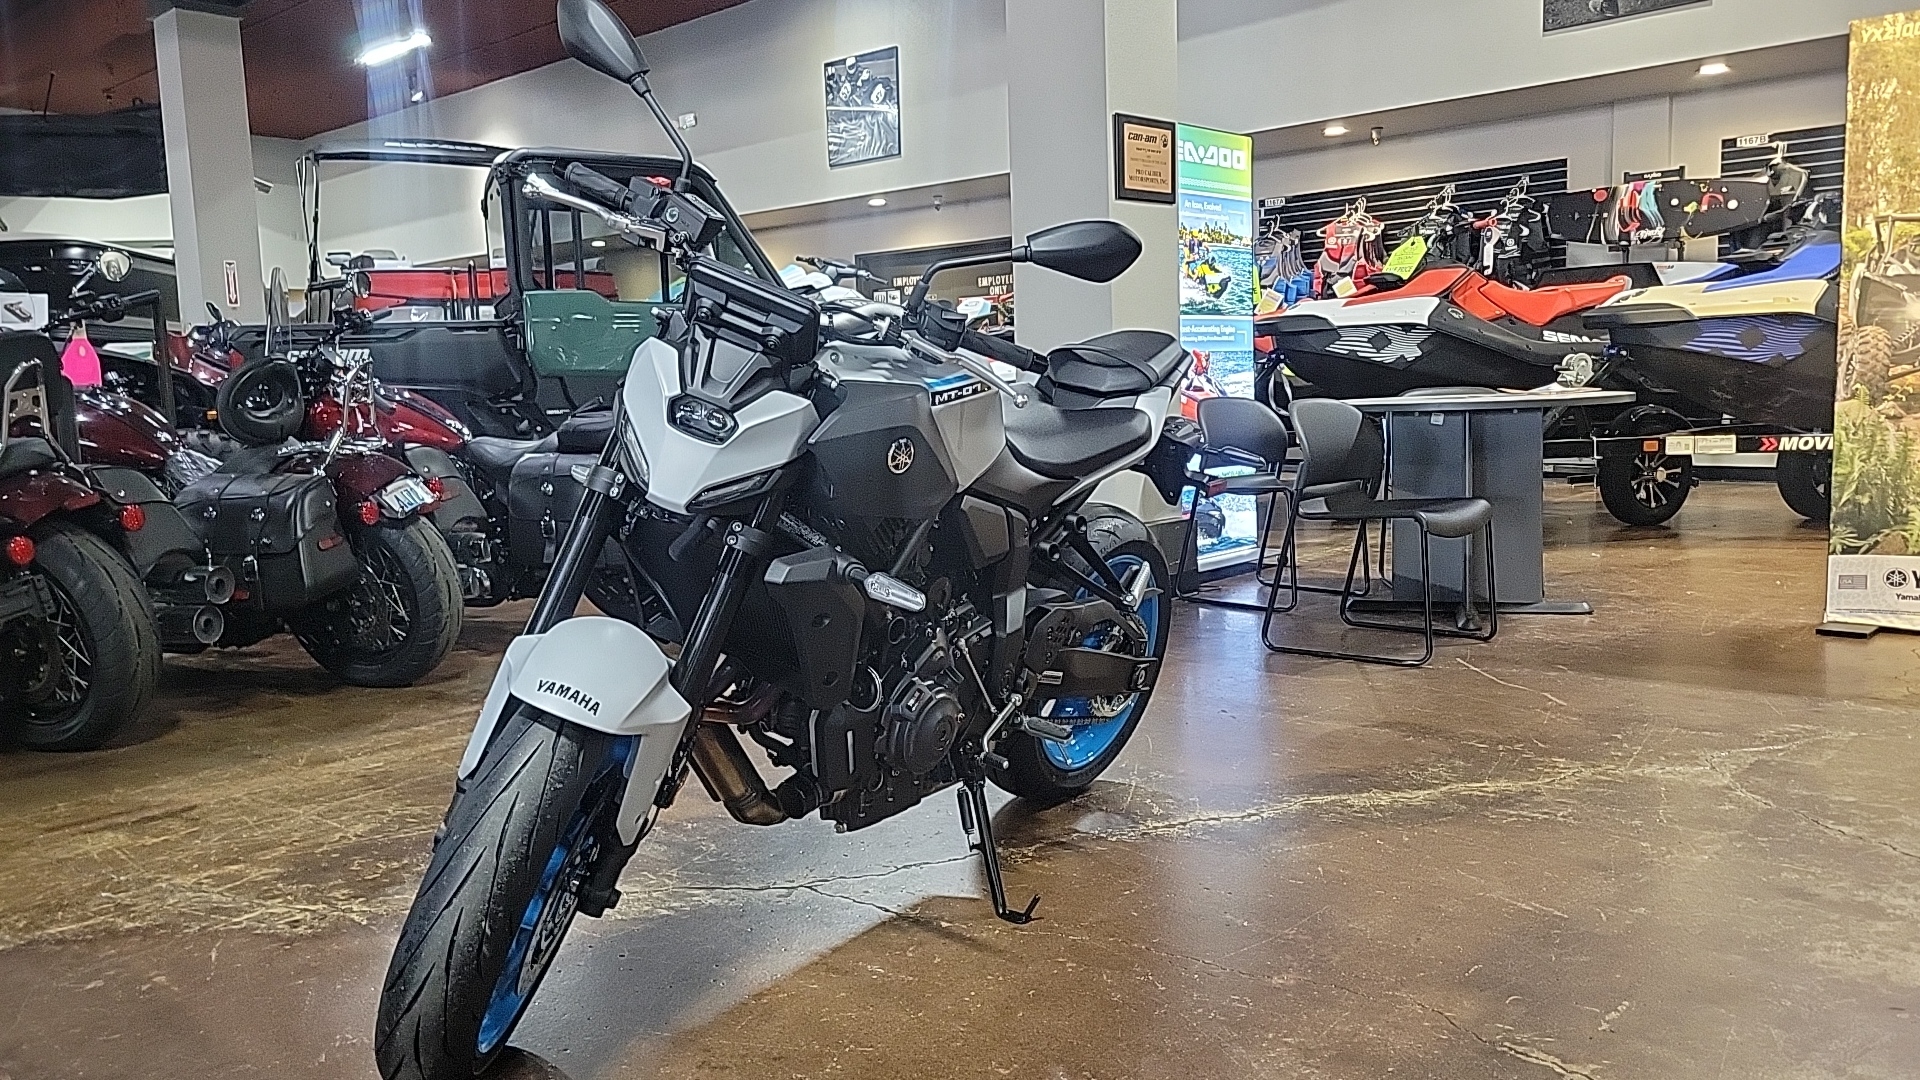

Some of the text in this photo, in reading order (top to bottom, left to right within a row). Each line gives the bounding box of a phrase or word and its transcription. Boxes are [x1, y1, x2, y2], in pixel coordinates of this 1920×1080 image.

[1128, 132, 1158, 144] can-am
[1739, 135, 1766, 146] 1167B
[990, 285, 1007, 295] ONLY
[935, 383, 982, 405] MT-07
[537, 680, 601, 716] YAMAHA
